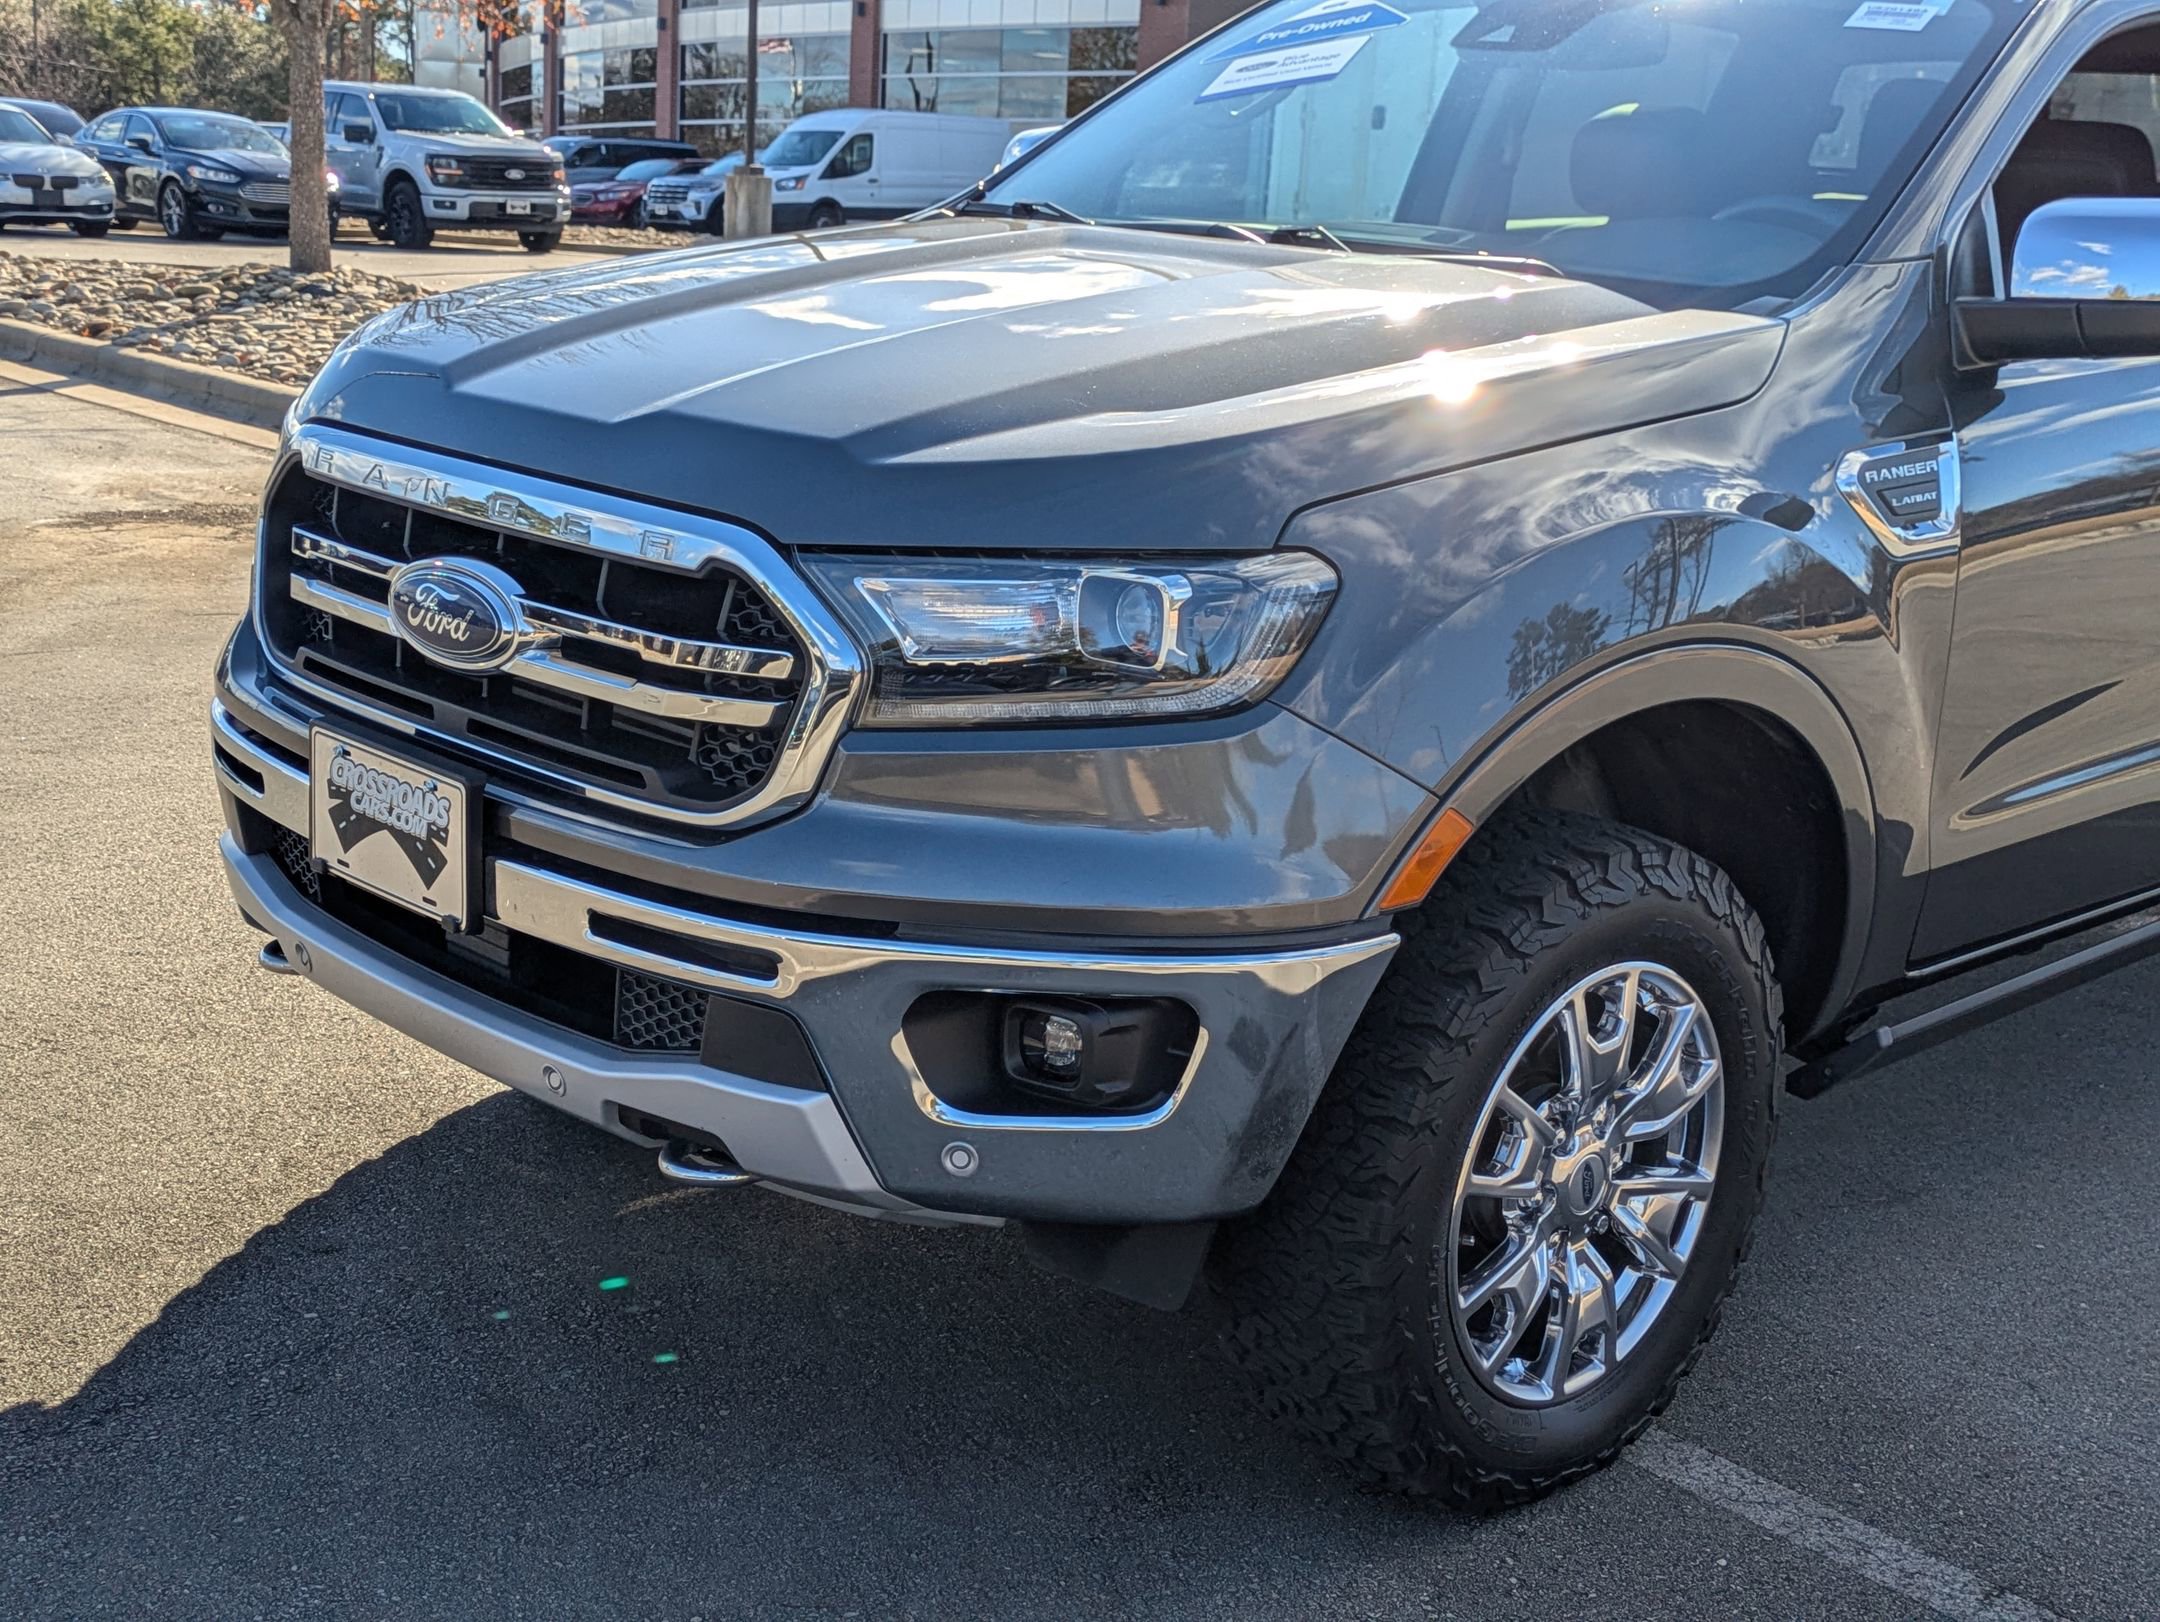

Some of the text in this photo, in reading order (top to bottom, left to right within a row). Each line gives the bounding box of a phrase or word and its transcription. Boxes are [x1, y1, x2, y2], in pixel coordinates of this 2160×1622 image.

[1256, 11, 1373, 44] Pre-Owned
[1864, 459, 1938, 484] RANGER
[312, 446, 678, 561] RANGER
[406, 582, 476, 643] Ford
[329, 755, 451, 828] CROSSROADS
[349, 790, 430, 841] CARS.COM
